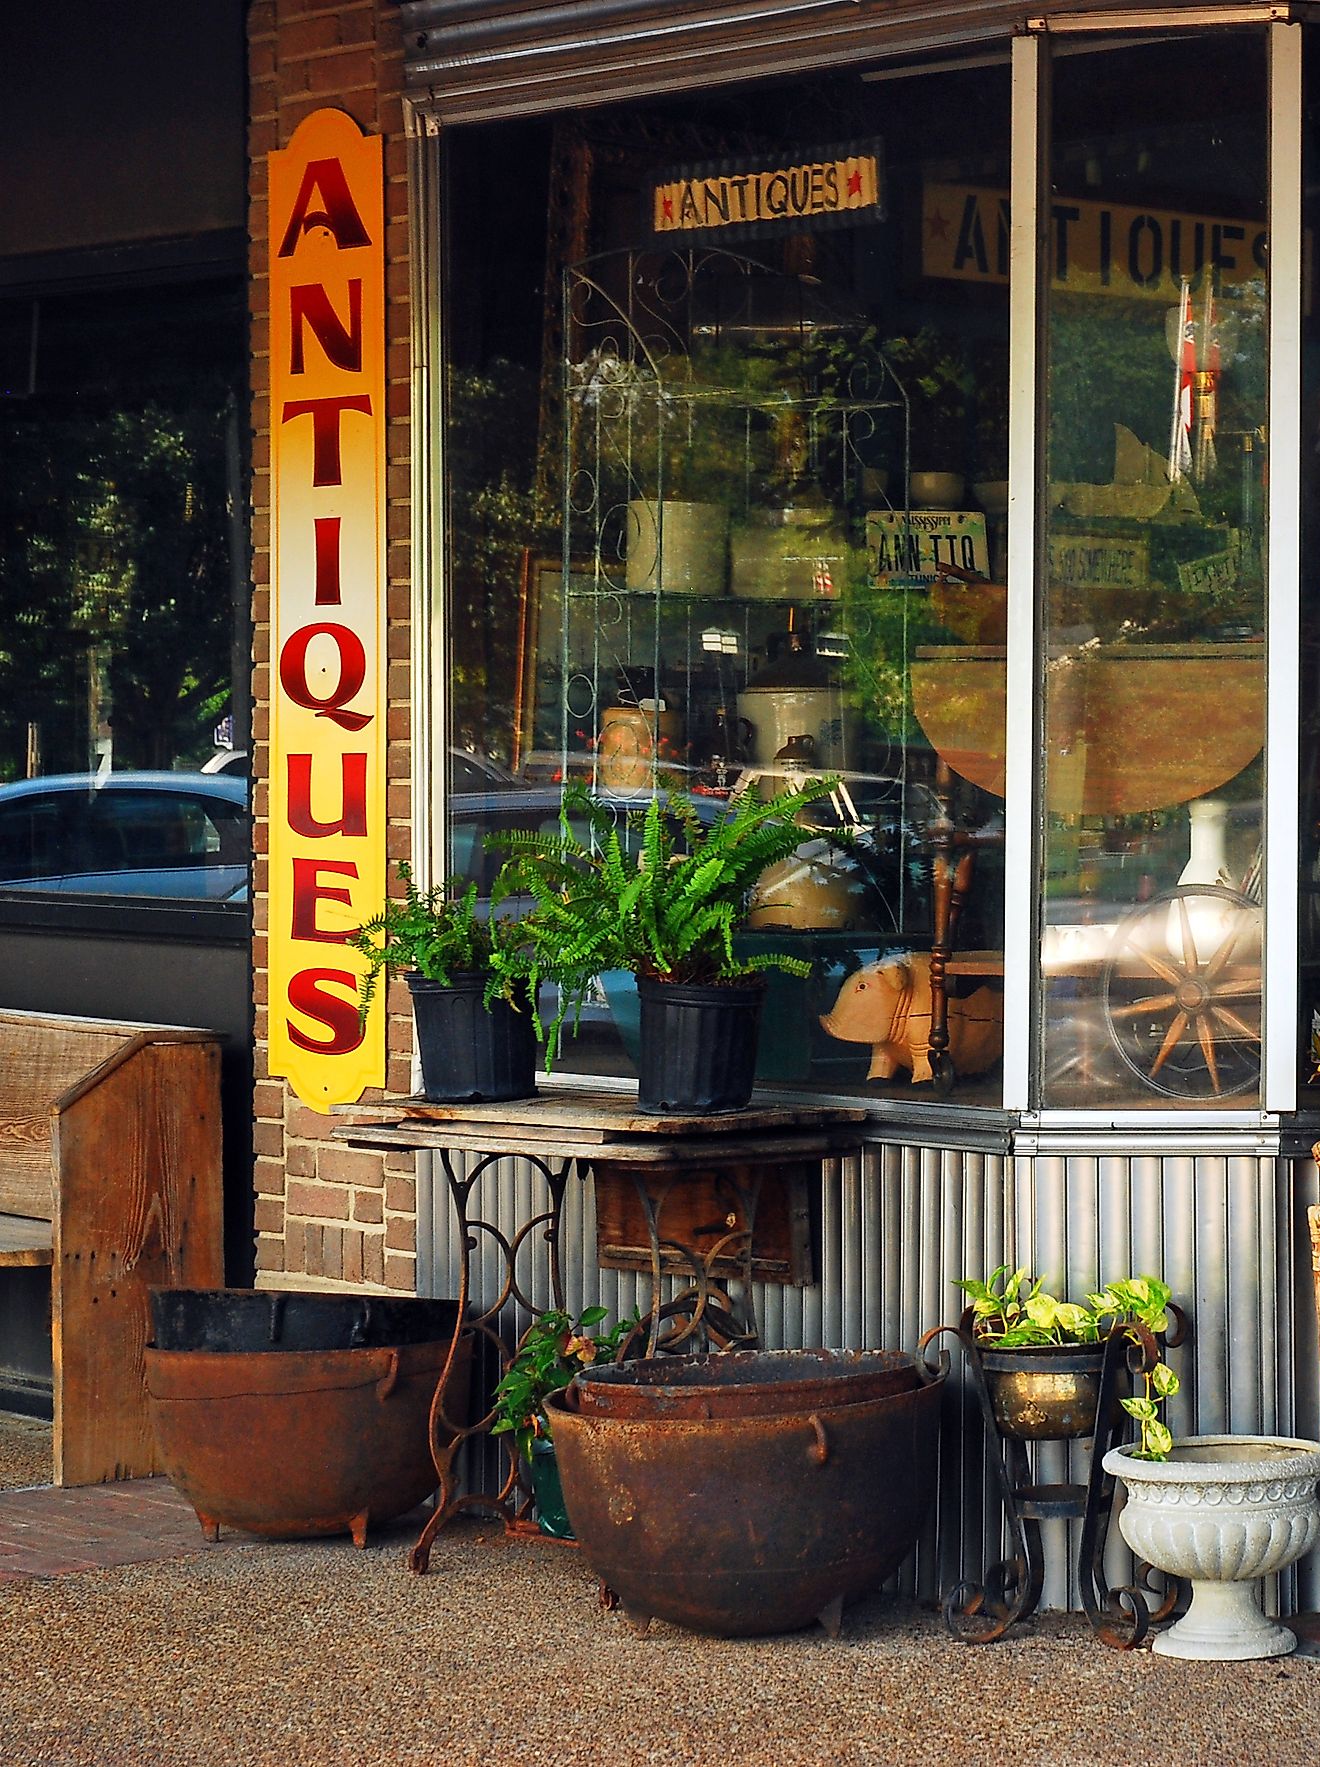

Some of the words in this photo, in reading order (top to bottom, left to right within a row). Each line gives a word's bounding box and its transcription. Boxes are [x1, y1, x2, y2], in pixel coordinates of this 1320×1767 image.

[679, 167, 839, 224] ANTIQUES
[879, 534, 920, 572] ANN
[278, 156, 373, 1056] ANTIQUES
